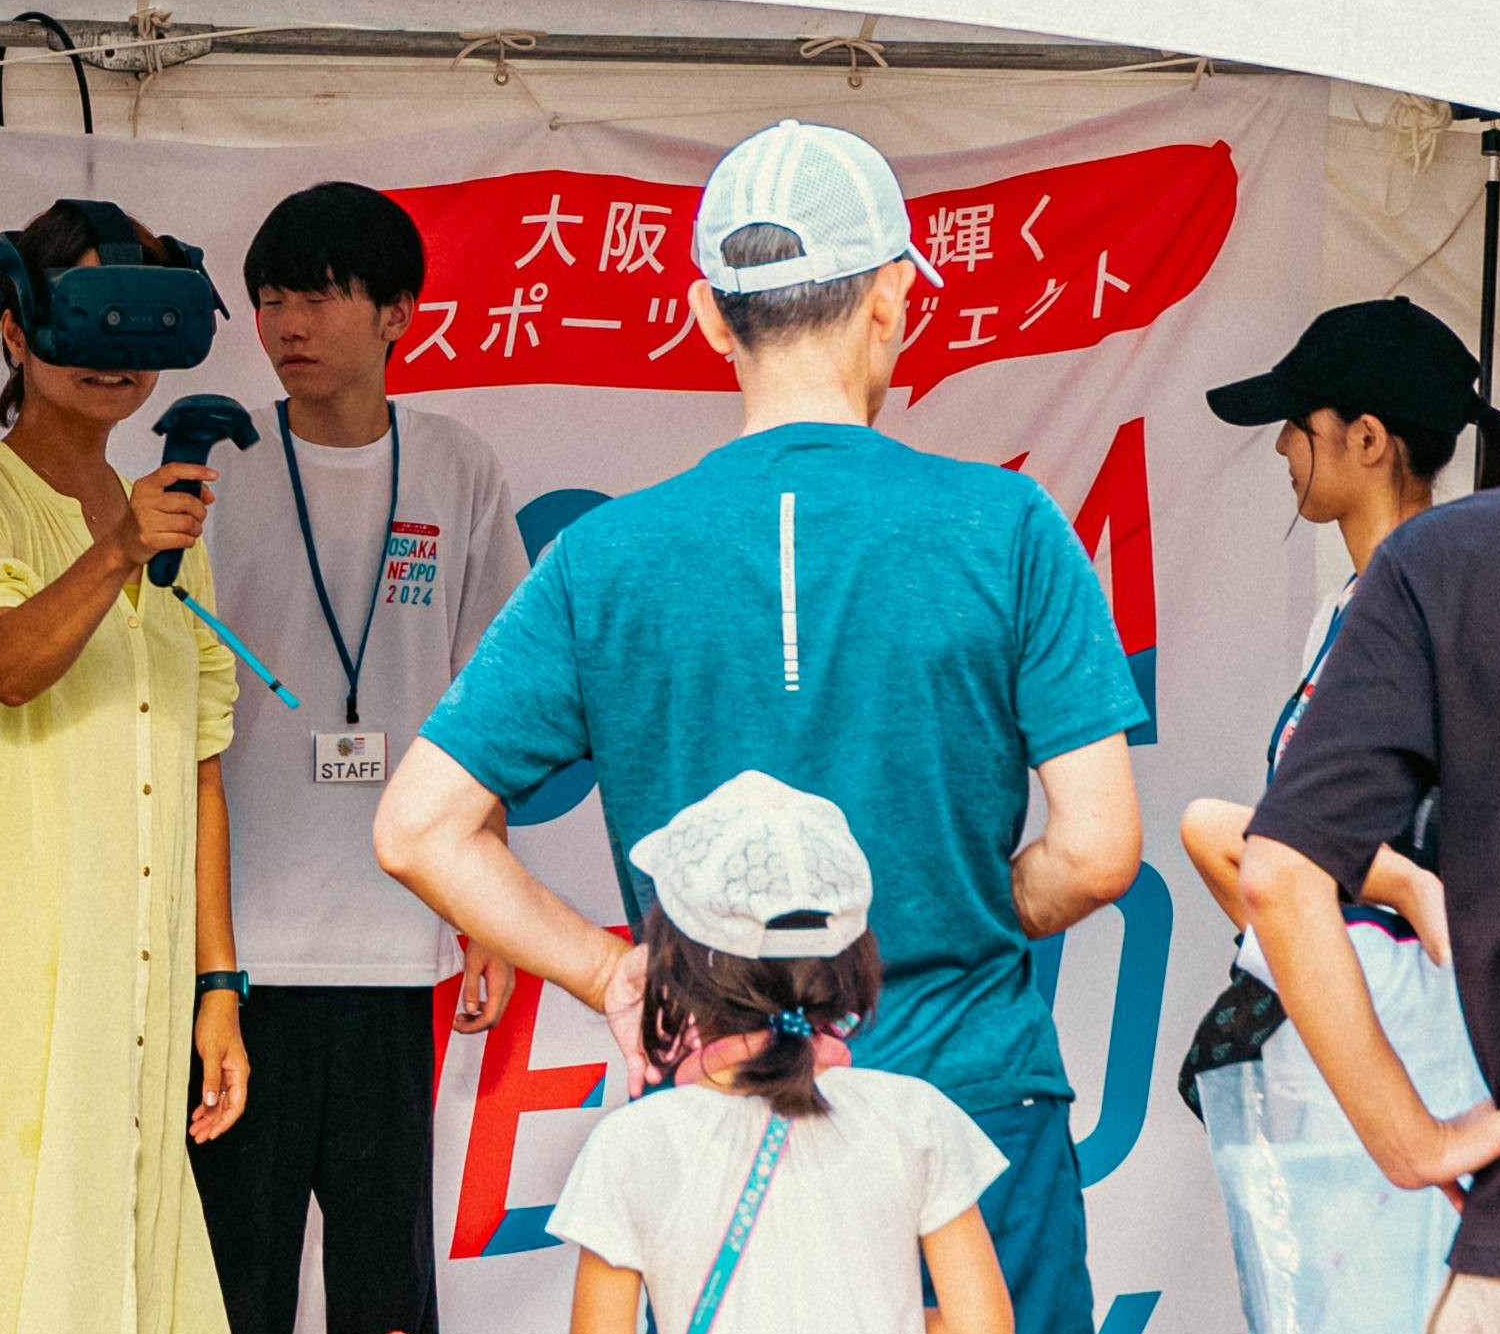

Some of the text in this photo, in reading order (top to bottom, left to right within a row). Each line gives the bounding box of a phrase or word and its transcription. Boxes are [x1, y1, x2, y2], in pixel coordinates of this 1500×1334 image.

[404, 251, 1132, 366] スポーツジェクト
[388, 538, 438, 560] OSAKA
[387, 561, 437, 583] NEXPO
[386, 584, 433, 605] 2024
[320, 760, 382, 781] STAFF
